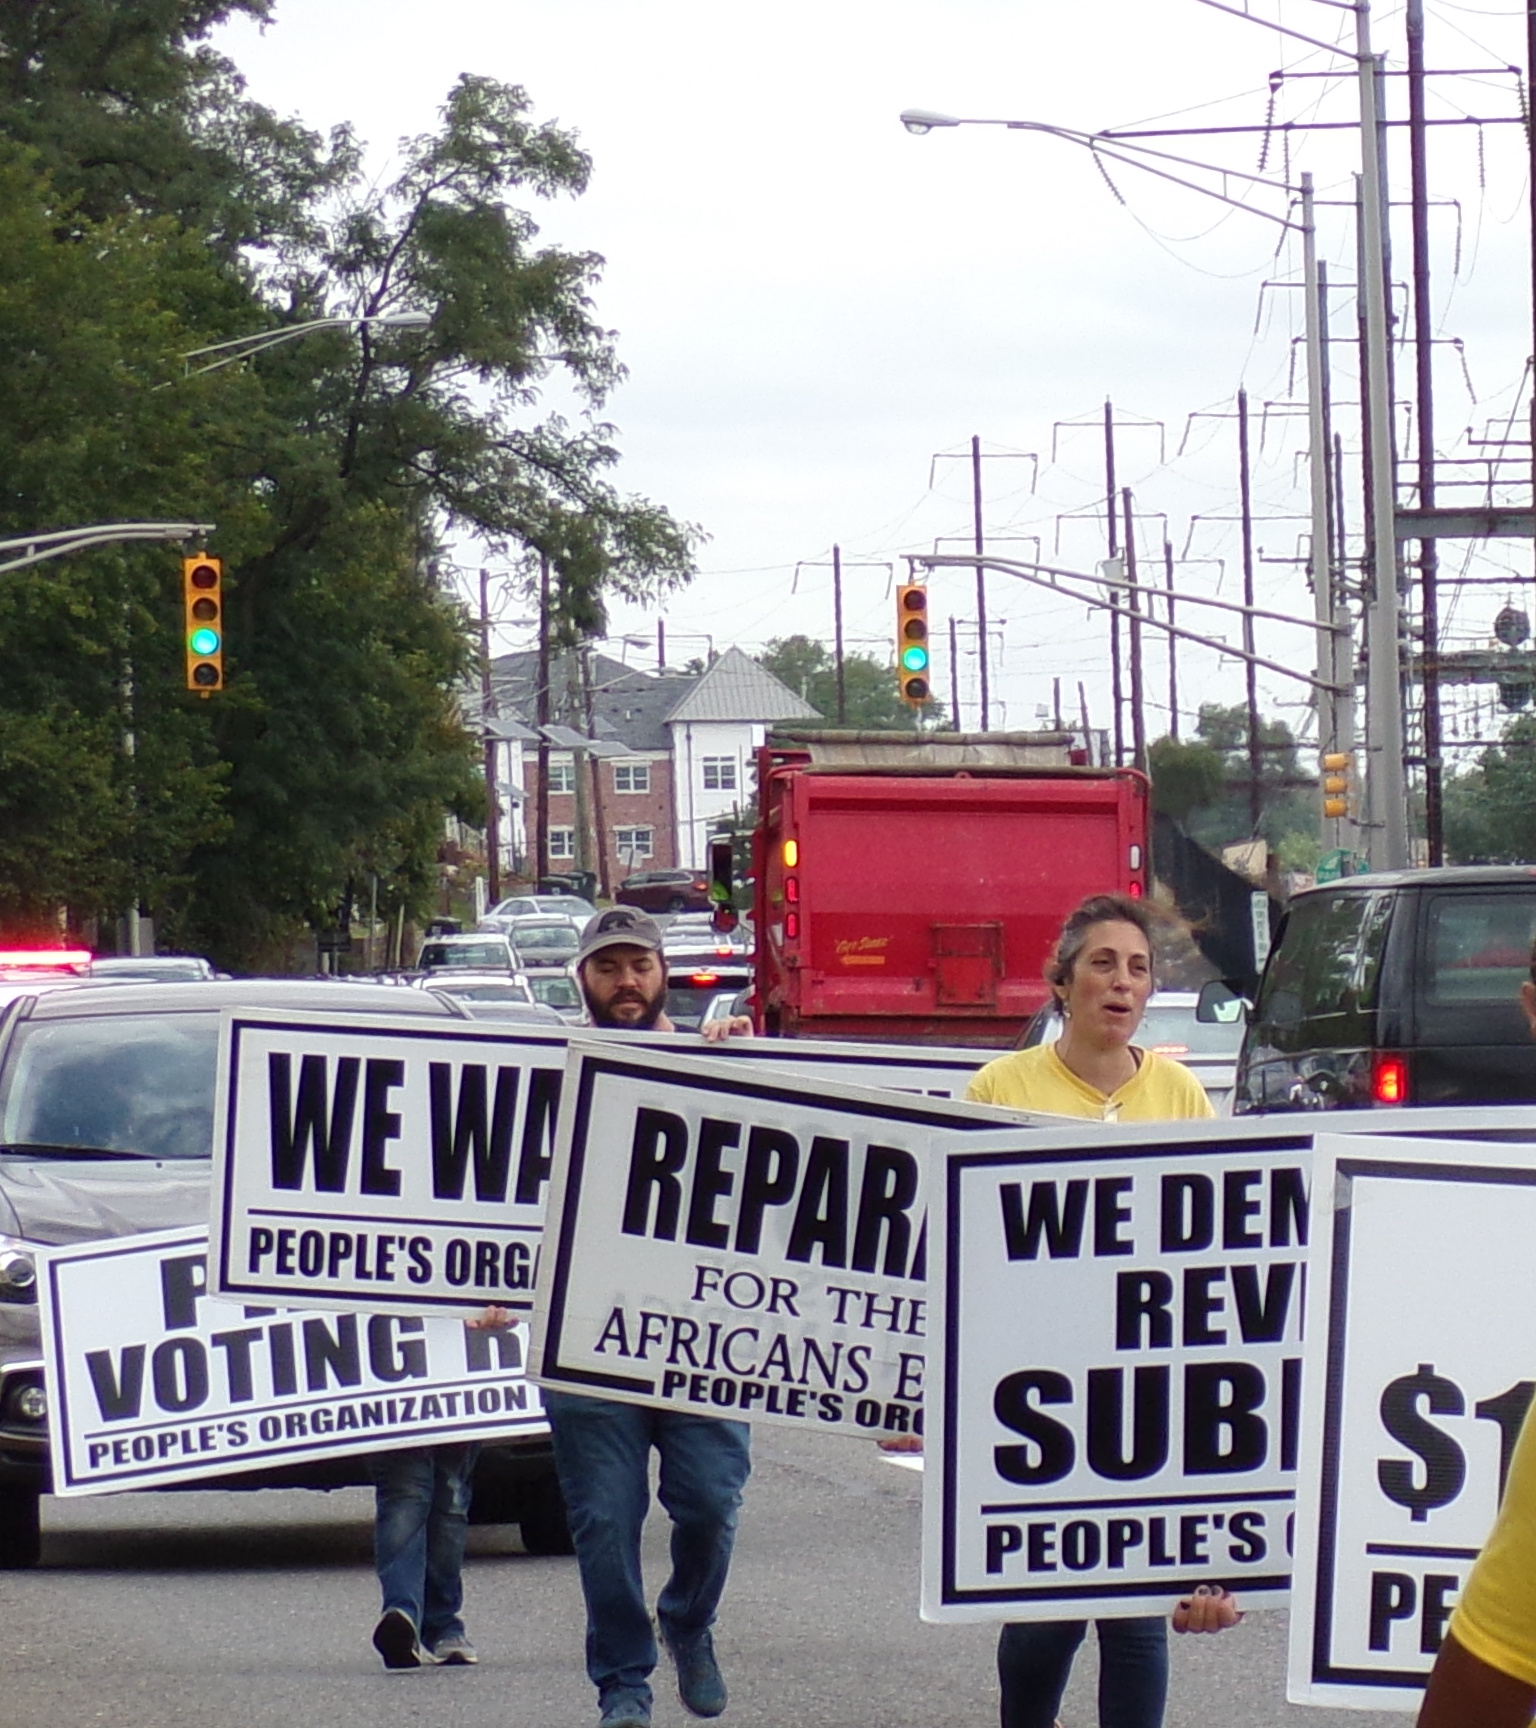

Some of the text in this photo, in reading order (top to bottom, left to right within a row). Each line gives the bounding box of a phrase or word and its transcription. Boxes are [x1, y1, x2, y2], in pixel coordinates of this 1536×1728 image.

[267, 1051, 564, 1205] WE WA
[620, 1106, 928, 1282] REPAR
[1000, 1176, 1134, 1262] WE
[247, 1227, 541, 1291] PEOPLE'S ORG
[691, 1264, 927, 1338] FOR THE
[1115, 1261, 1307, 1352] REV
[86, 1313, 428, 1422] VOTING
[594, 1307, 873, 1394] AFRICANS
[88, 1420, 249, 1469] PEOPLE'S
[259, 1384, 528, 1443] ORGANIZATION
[662, 1370, 843, 1422] PEOPLE'S
[985, 1510, 1268, 1575] PEOPLE'S
